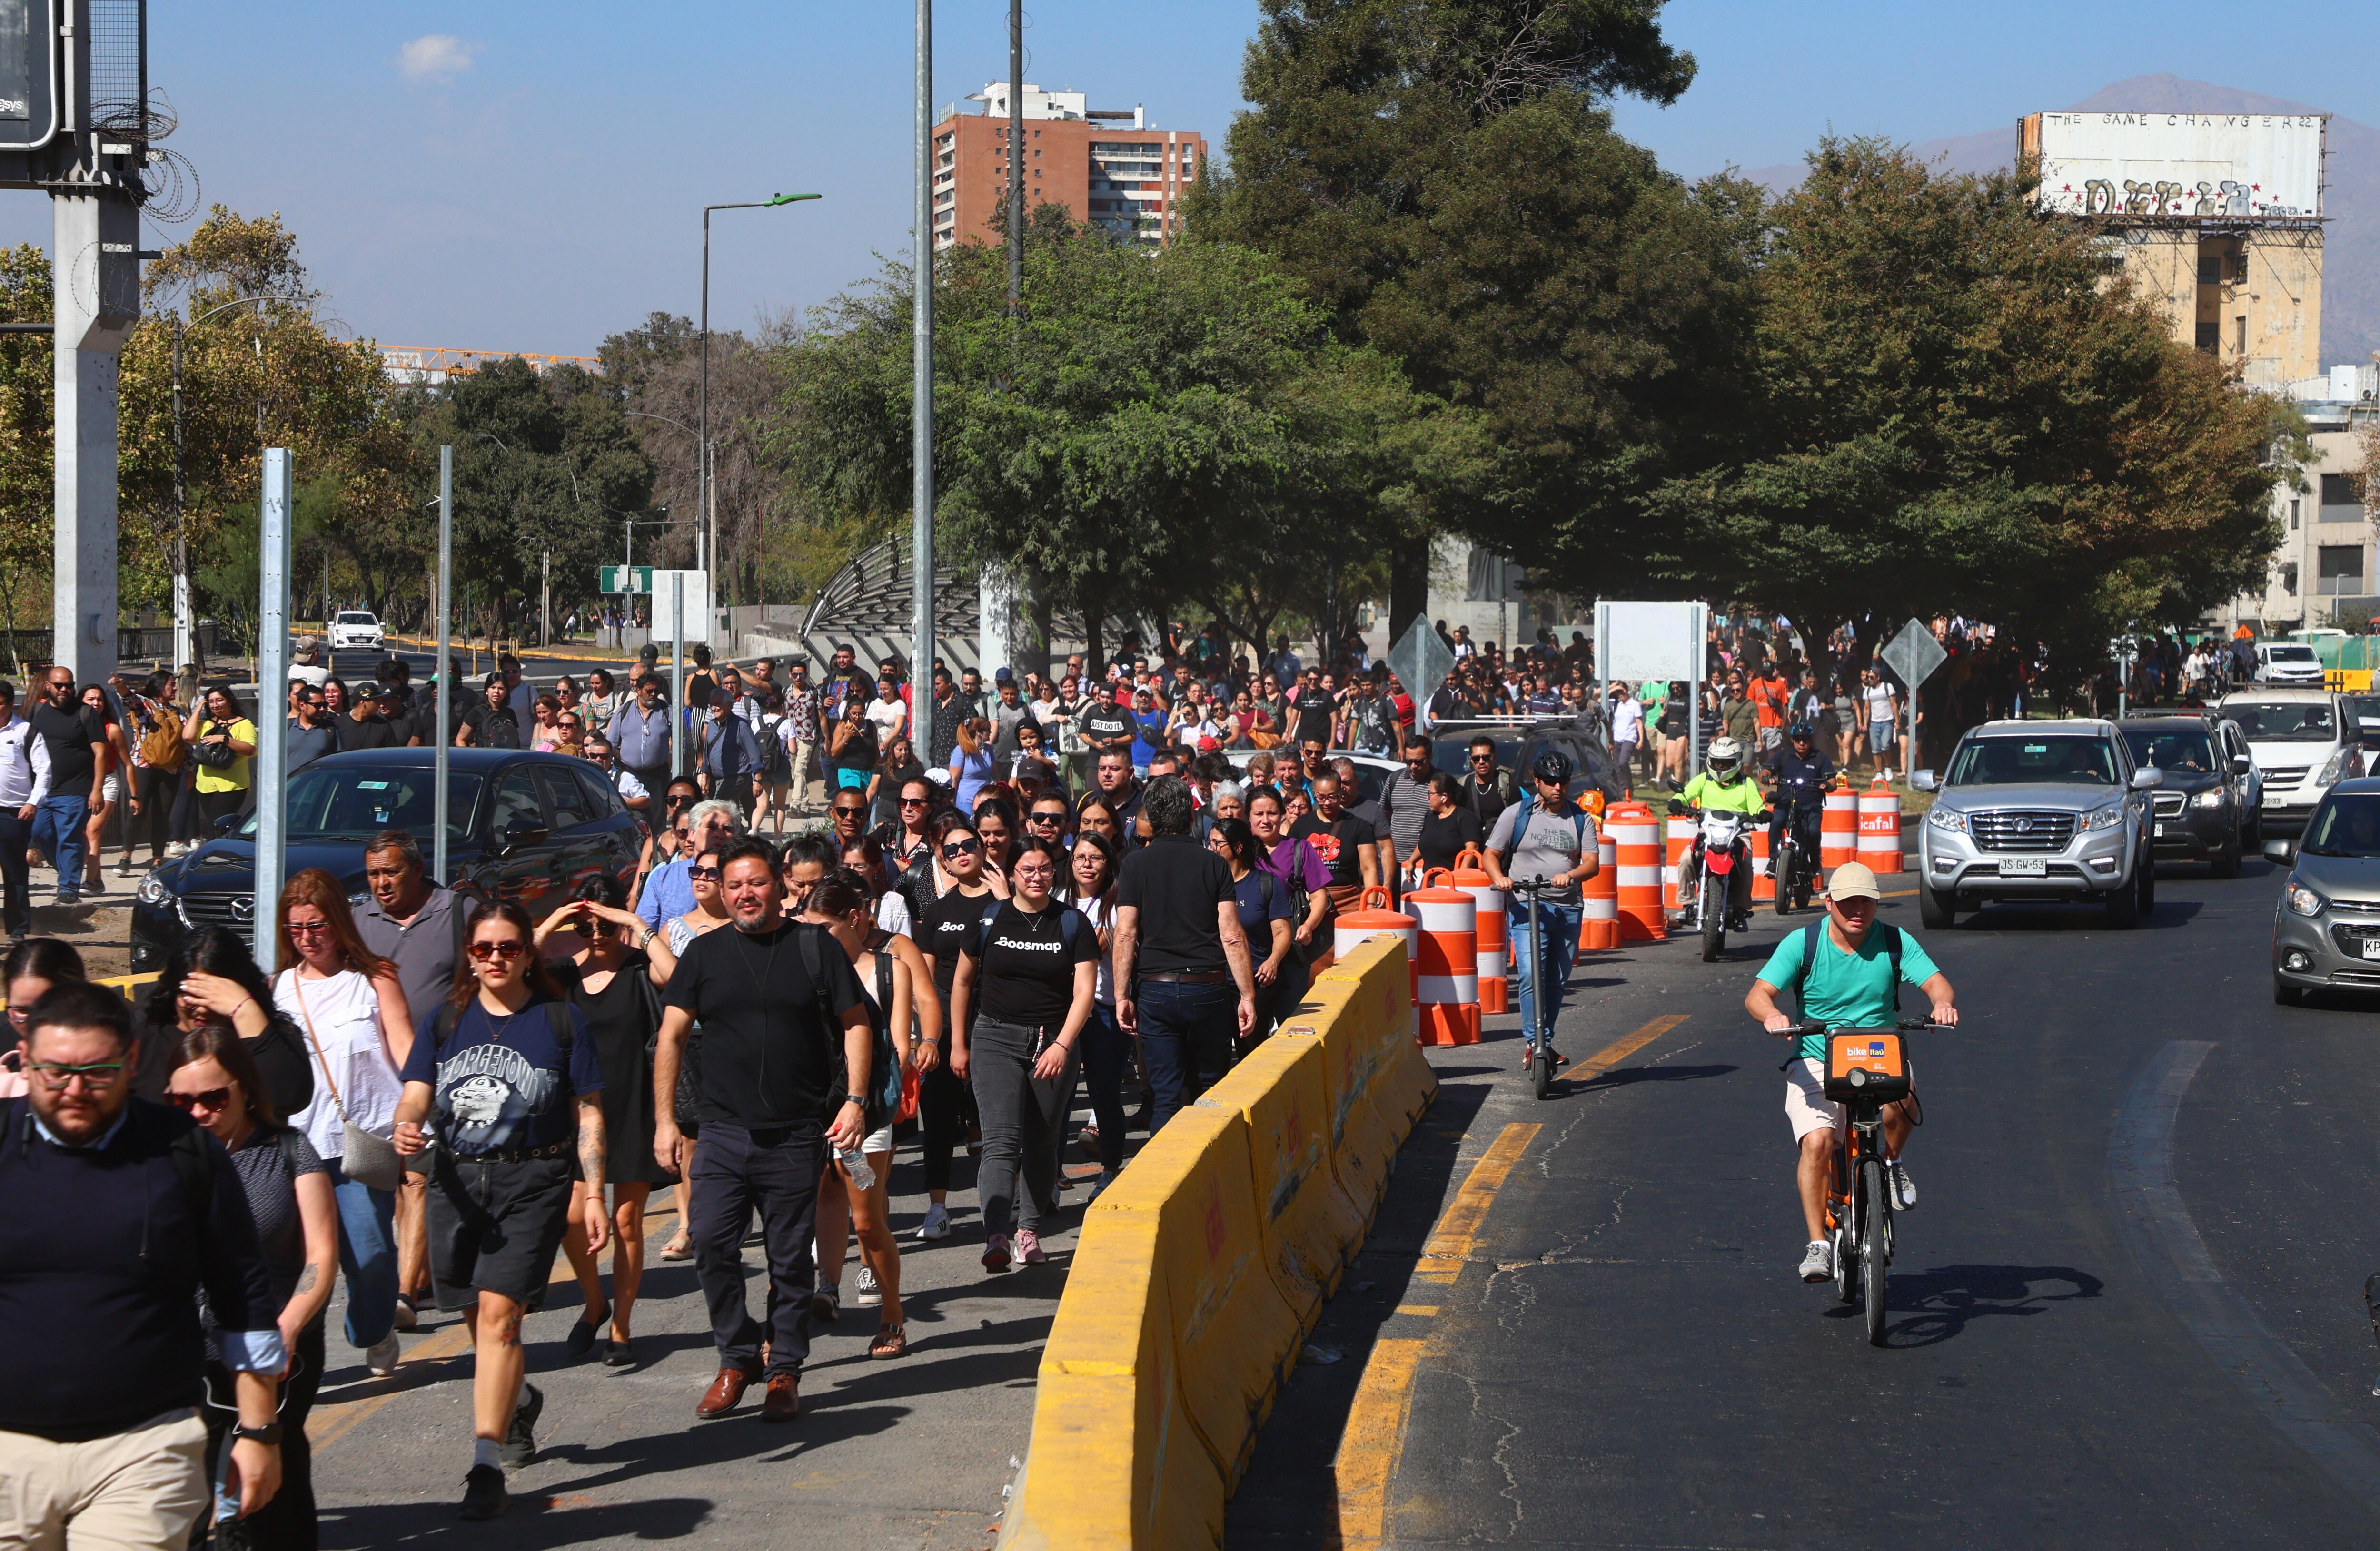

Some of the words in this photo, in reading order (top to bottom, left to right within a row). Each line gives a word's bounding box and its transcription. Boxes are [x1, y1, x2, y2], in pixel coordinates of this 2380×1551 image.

[2047, 115, 2081, 125] THE
[2103, 114, 2147, 126] GAME
[1091, 721, 1104, 729] JUST
[1860, 815, 1894, 830] icafal
[1543, 828, 1559, 836] THE
[1531, 833, 1560, 842] NORTH
[1538, 840, 1560, 849] FACE
[994, 936, 1061, 954] Boosmap
[1847, 1047, 1867, 1056] bike
